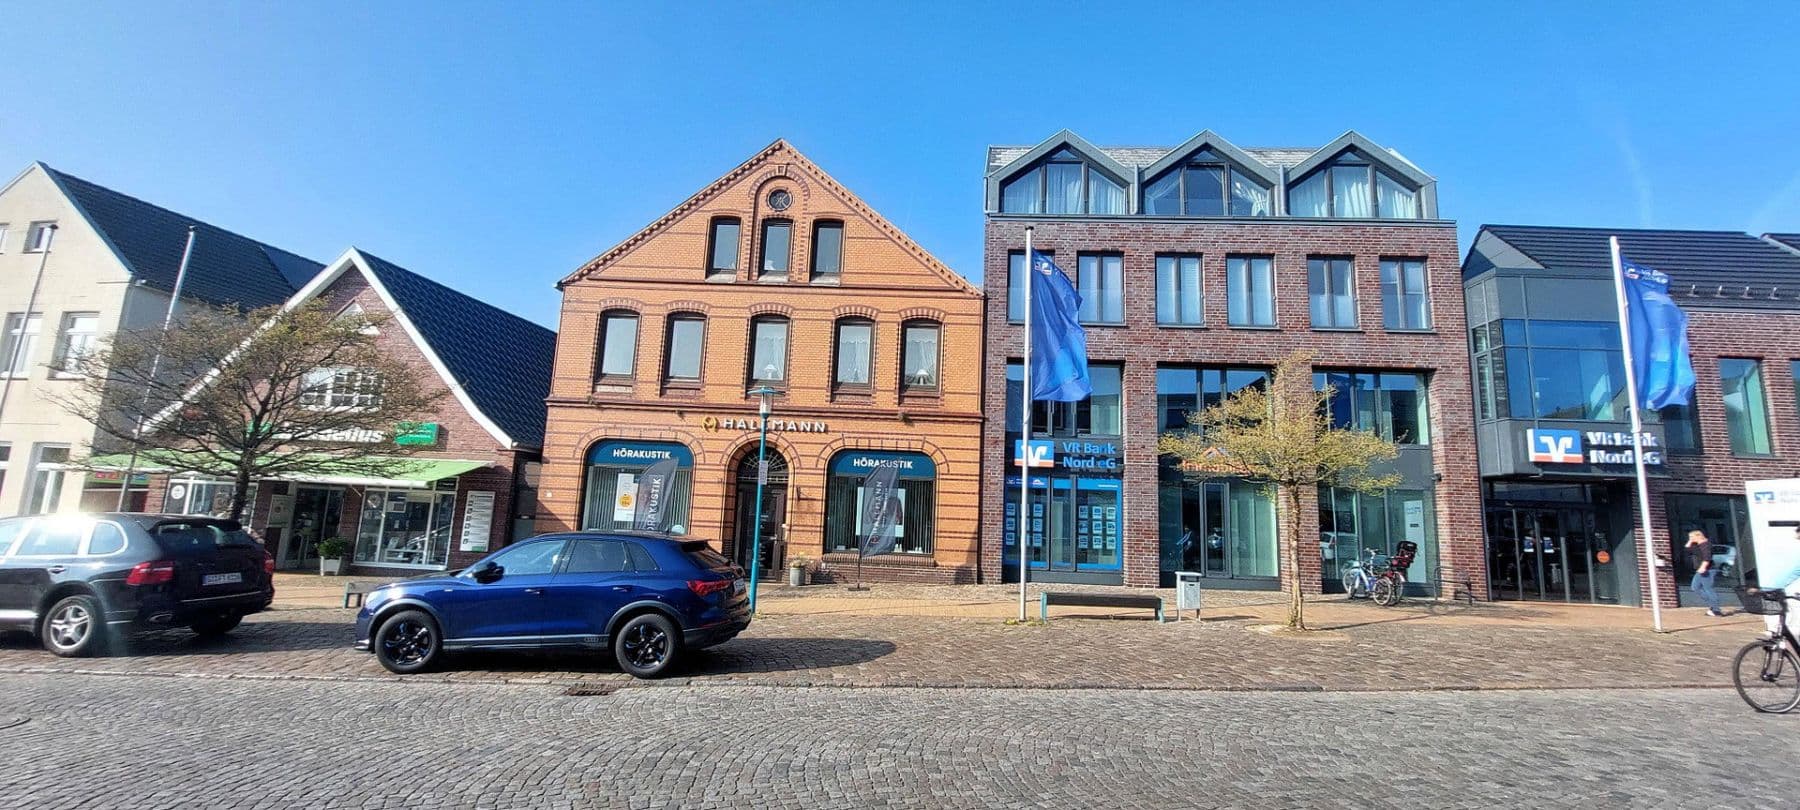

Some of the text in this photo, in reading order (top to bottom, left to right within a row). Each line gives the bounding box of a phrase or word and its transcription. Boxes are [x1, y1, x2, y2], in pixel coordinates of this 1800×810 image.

[723, 418, 826, 432] HALMANN
[1586, 431, 1658, 446] VR Bak
[613, 448, 672, 459] HÖRAKUSTIK
[1062, 441, 1116, 454] VR Bank
[853, 457, 913, 469] HÖRAKUSTIK
[1063, 457, 1116, 469] Nord eG
[1589, 449, 1634, 464] Nord
